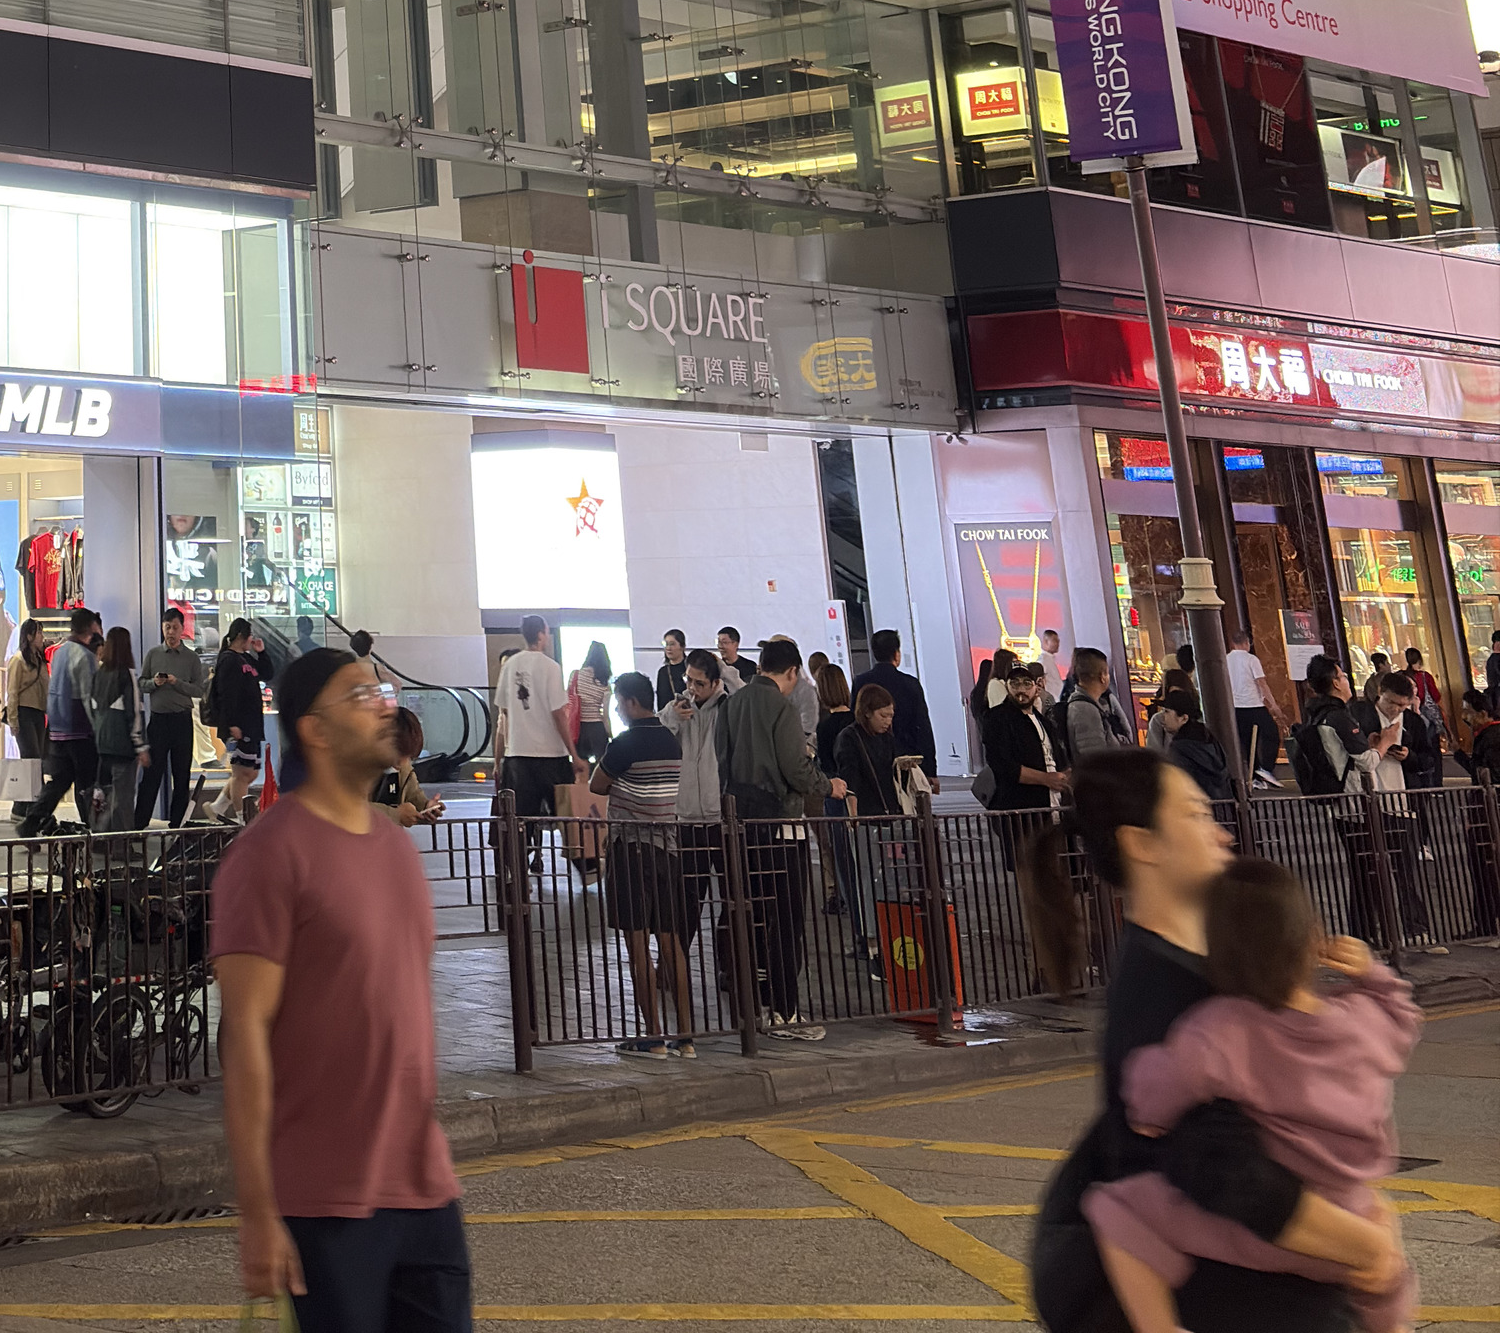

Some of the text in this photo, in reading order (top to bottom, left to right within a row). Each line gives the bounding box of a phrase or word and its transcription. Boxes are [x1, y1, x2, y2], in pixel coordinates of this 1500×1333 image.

[1087, 15, 1110, 88] WORLD
[974, 87, 1013, 104] 周大福
[1098, 89, 1118, 141] CITY
[1105, 42, 1138, 140] KONG
[625, 283, 769, 347] SQUARE
[678, 355, 773, 389] 國際廣場
[1220, 340, 1311, 396] 周大福
[1322, 368, 1403, 391] CHOW TAI FOOK
[960, 529, 1049, 541] CHOW TAI FOOK
